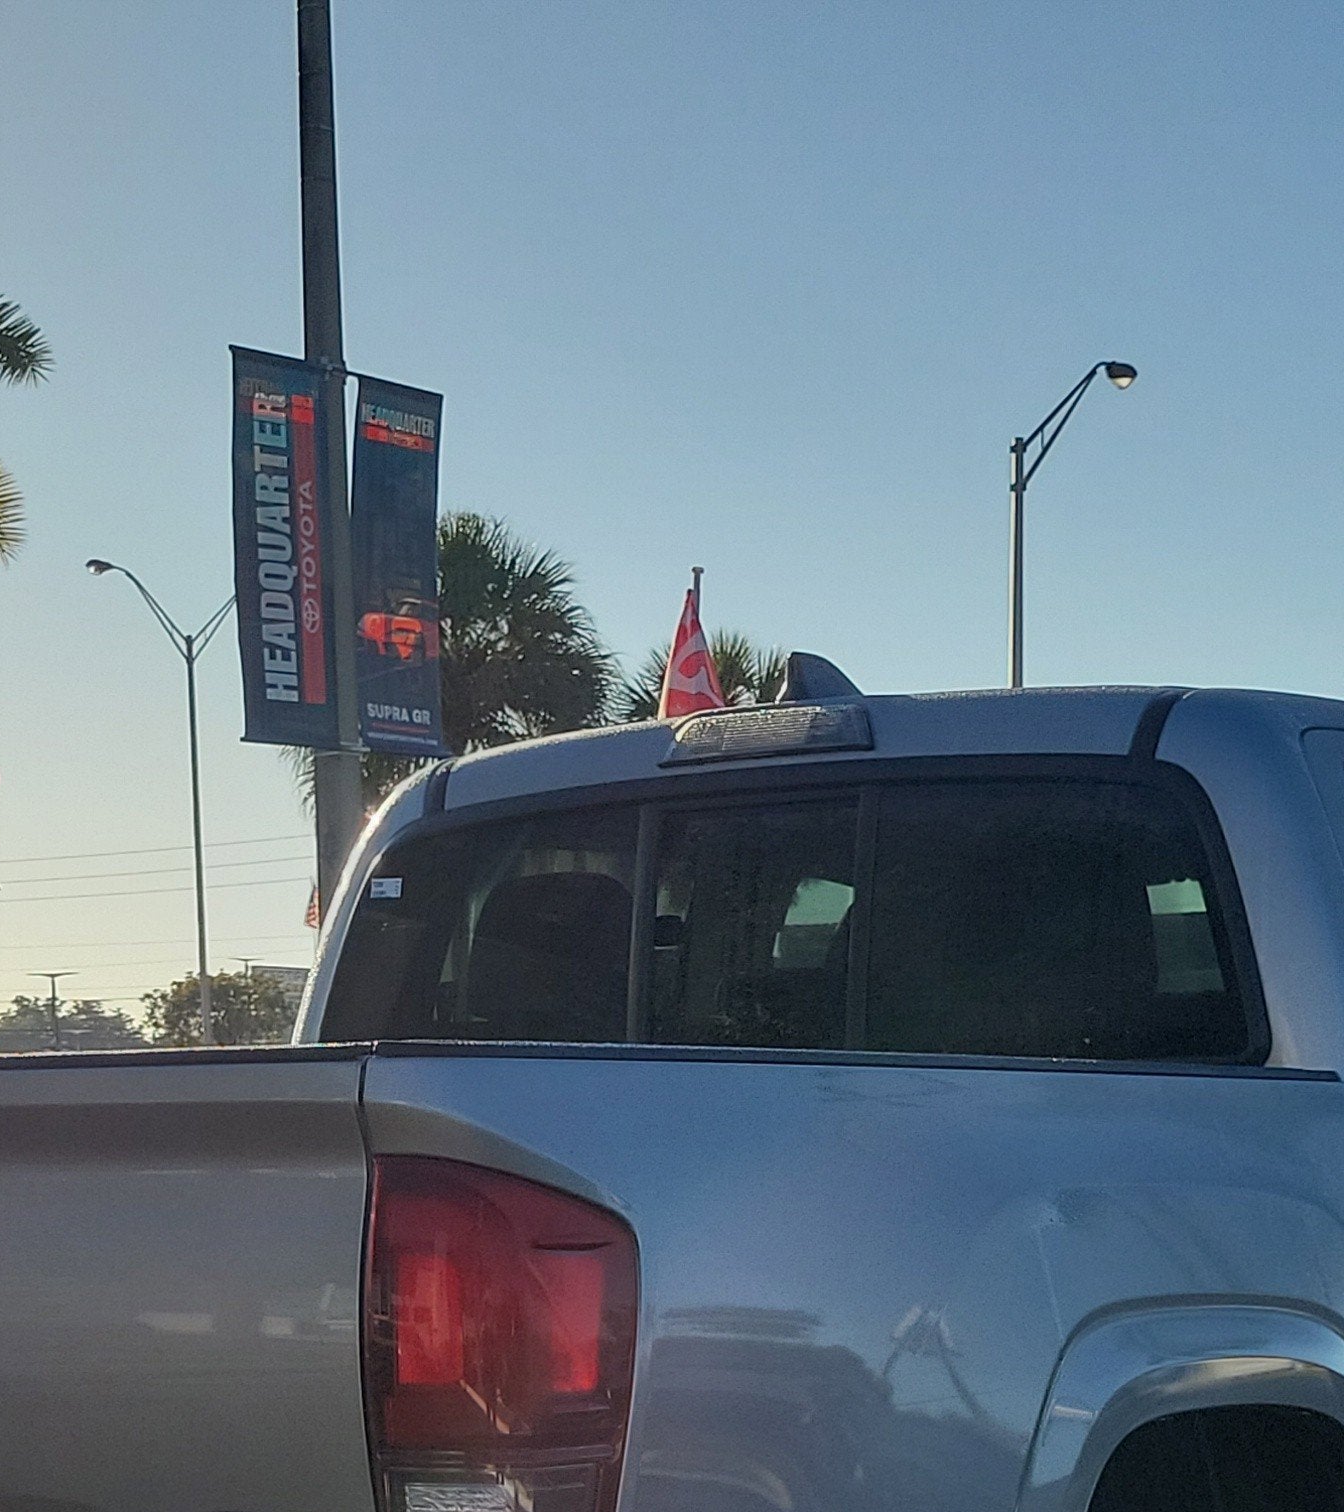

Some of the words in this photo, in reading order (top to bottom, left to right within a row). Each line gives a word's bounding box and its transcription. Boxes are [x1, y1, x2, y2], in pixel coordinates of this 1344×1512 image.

[360, 402, 435, 438] HEADQUARTER
[252, 390, 300, 702] HEADQUARTER
[296, 481, 318, 592] TOYOTA
[367, 703, 409, 722] SUPRA
[412, 709, 430, 725] GR
